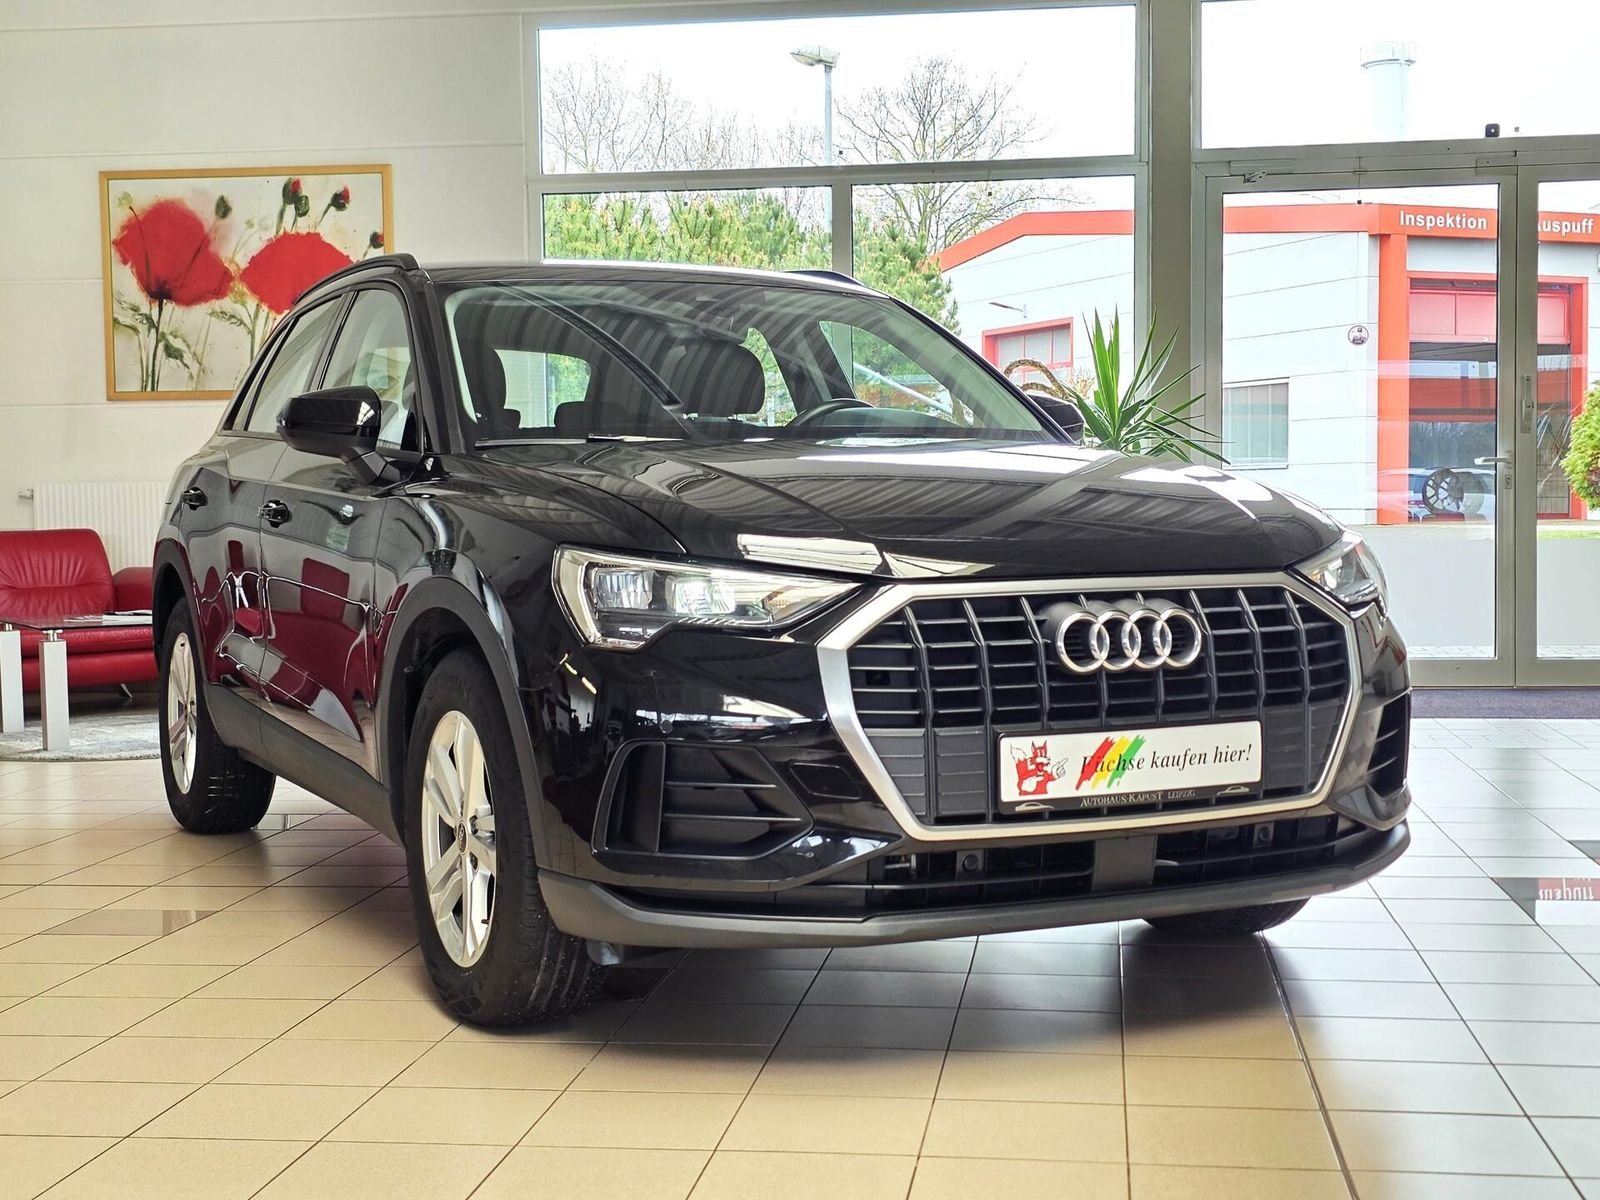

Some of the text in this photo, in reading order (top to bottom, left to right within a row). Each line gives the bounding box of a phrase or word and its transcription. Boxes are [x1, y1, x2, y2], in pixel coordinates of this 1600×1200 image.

[1400, 210, 1487, 230] Inspektion
[1538, 218, 1594, 237] uspuff
[1151, 748, 1207, 771] kaufen
[1213, 744, 1252, 765] hier!
